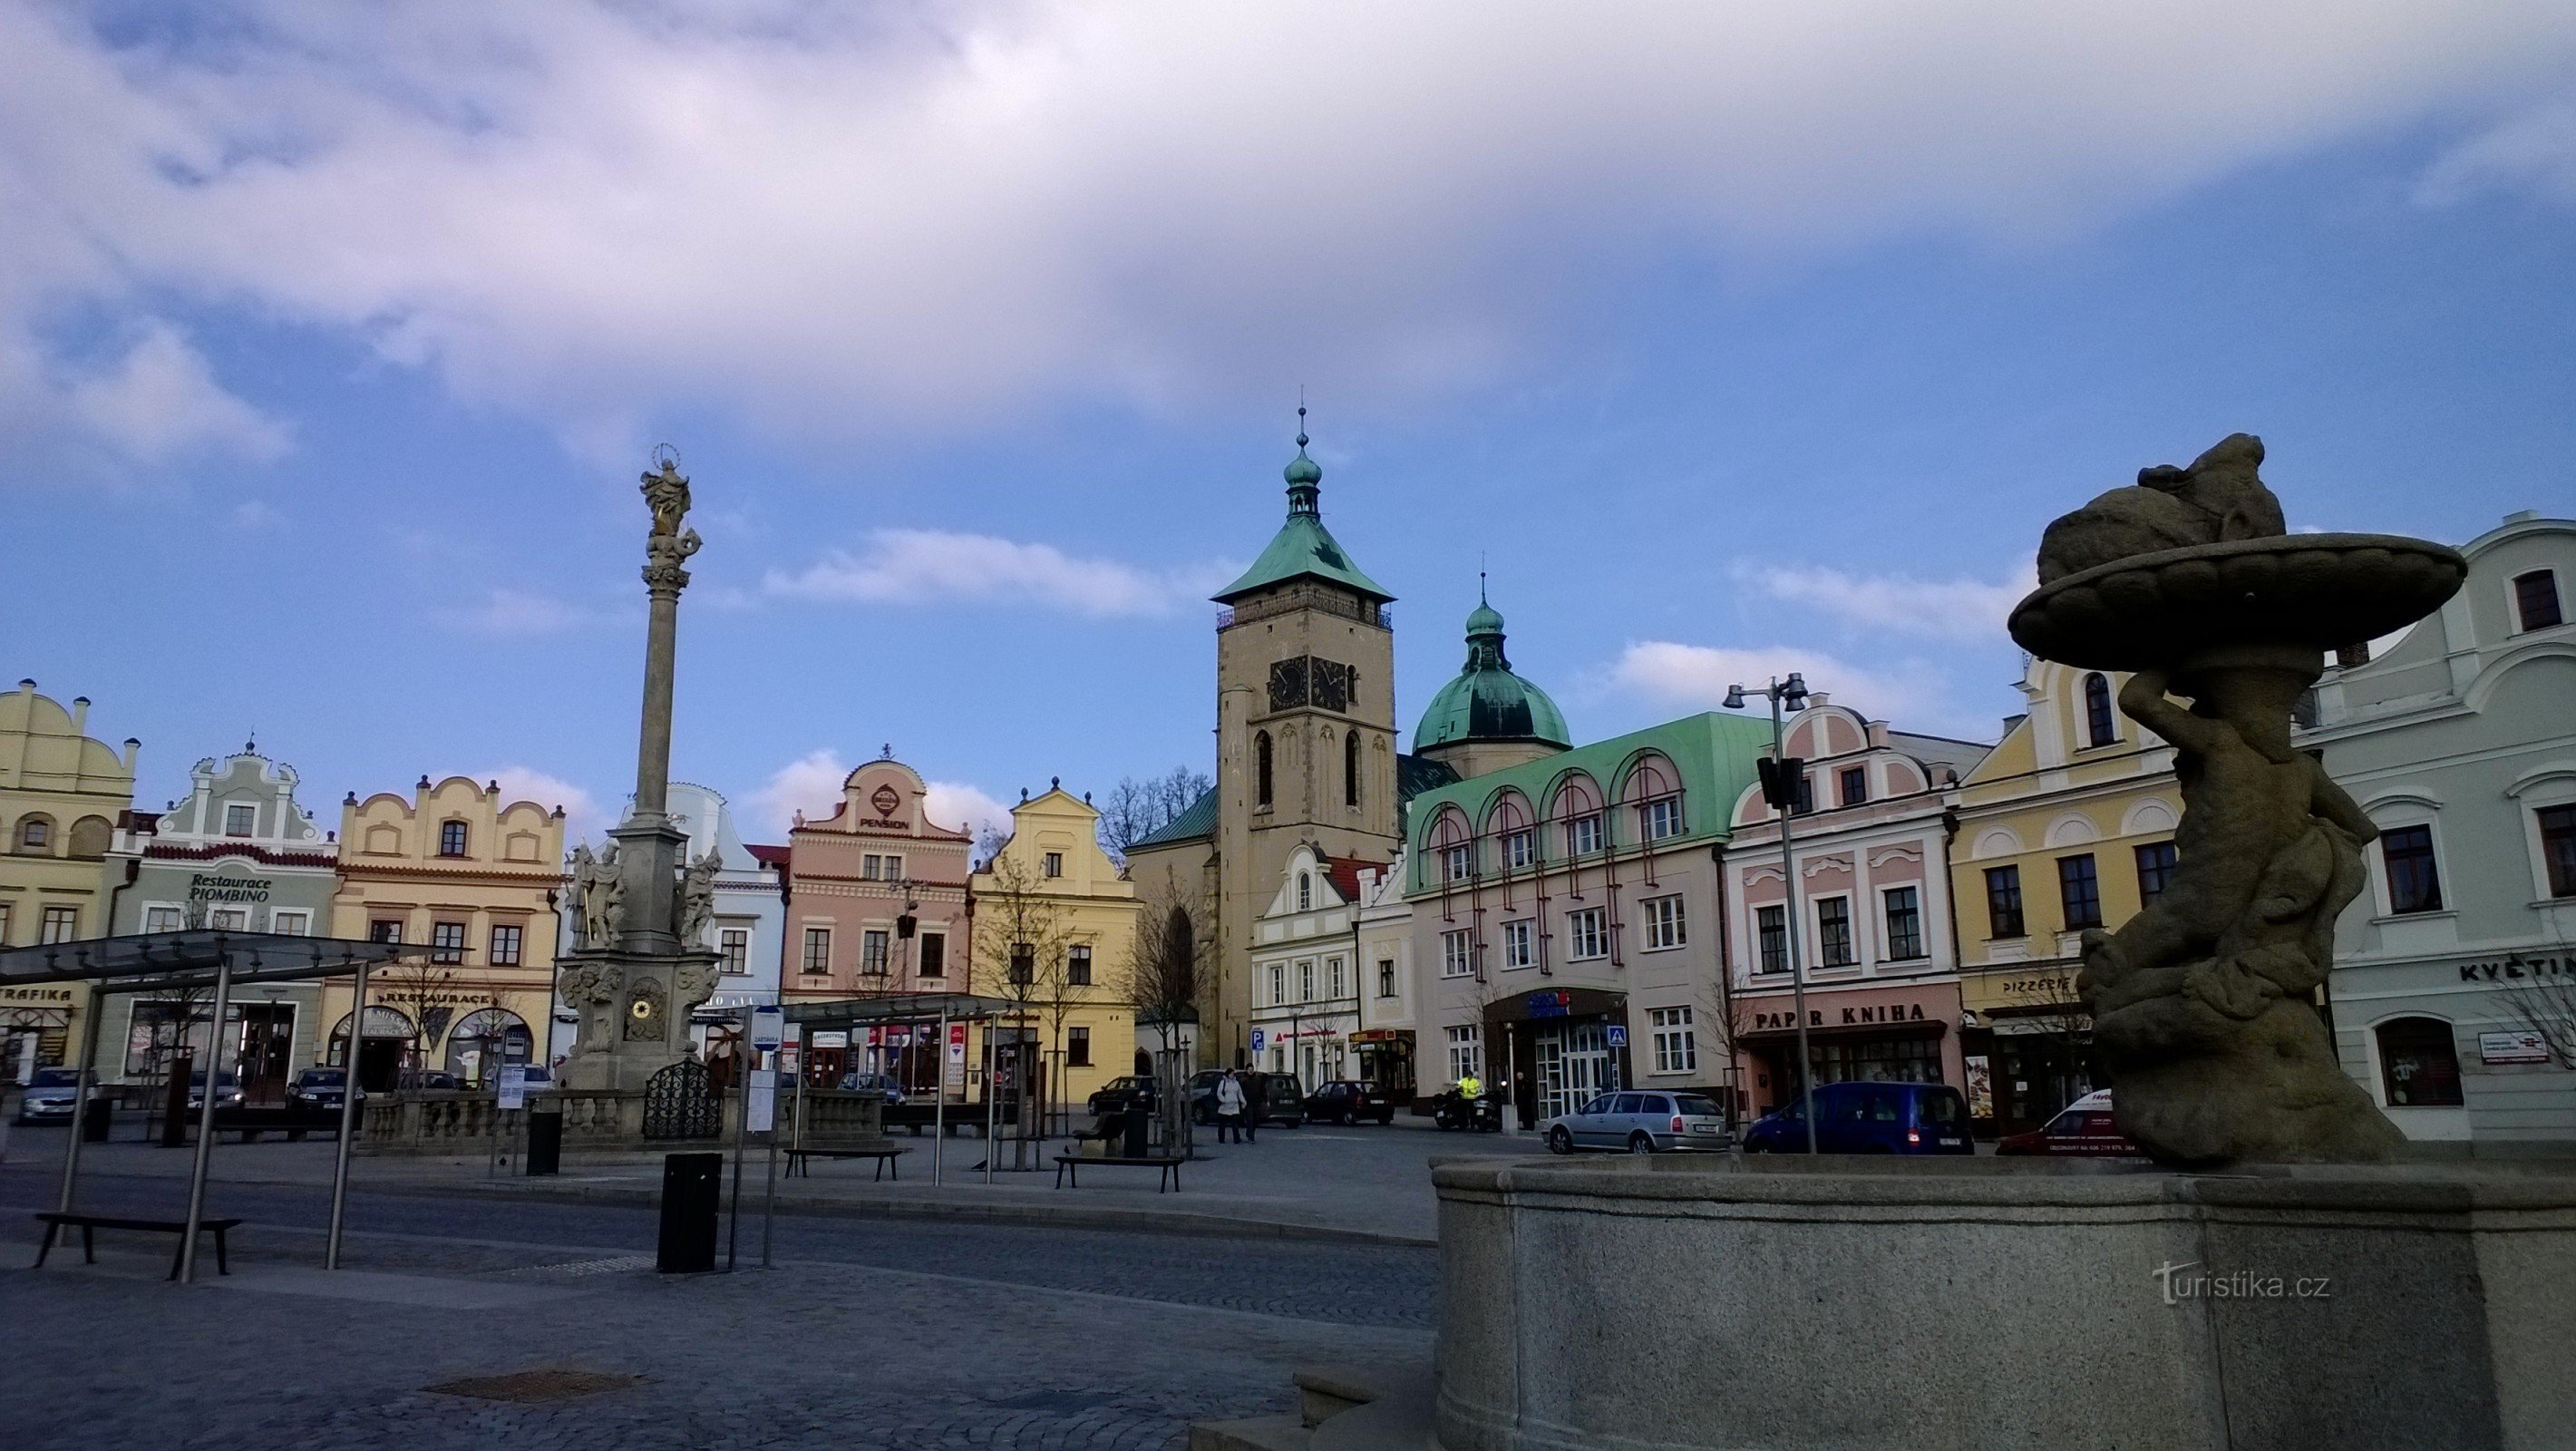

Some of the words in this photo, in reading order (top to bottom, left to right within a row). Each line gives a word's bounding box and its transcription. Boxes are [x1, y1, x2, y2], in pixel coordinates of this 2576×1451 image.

[860, 818, 909, 830] PENSION
[191, 873, 272, 889] Restaurace
[189, 888, 269, 902] PIOMBINO
[2002, 978, 2070, 993] PIZZERIE
[0, 988, 71, 1001] RAFIKA
[386, 992, 491, 1004] RESTAURACE
[1755, 1010, 1823, 1028] PAPR
[1842, 1003, 1925, 1024] KNIHA
